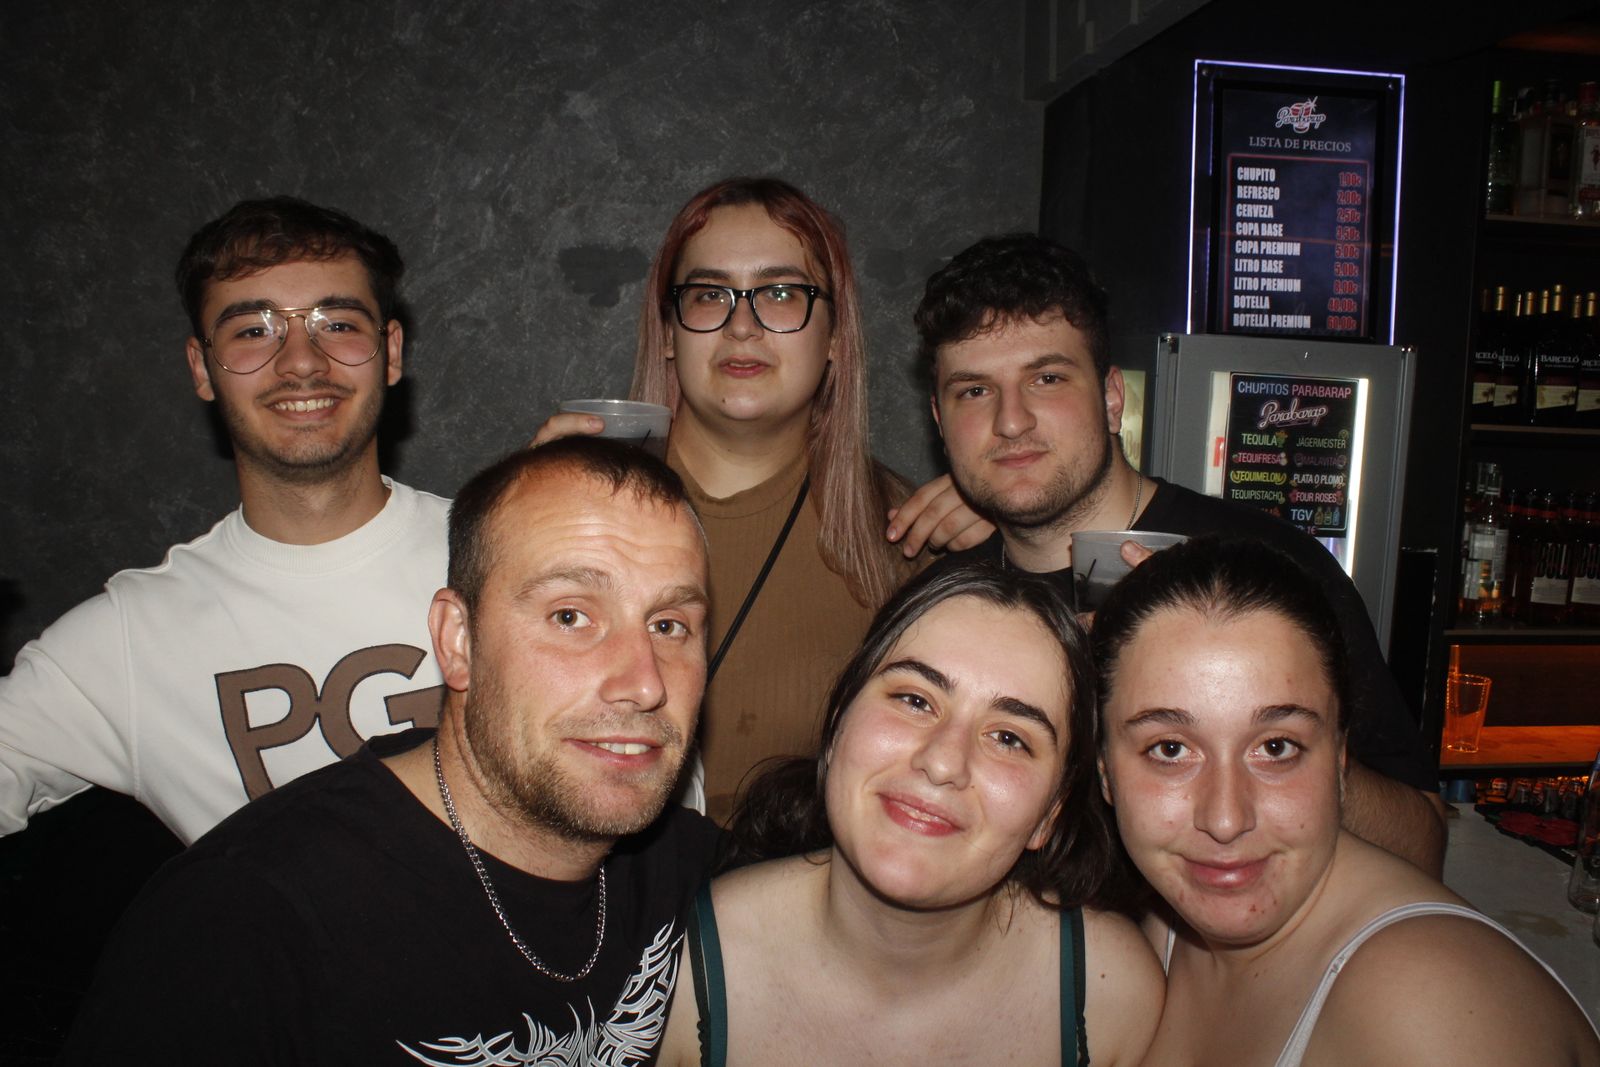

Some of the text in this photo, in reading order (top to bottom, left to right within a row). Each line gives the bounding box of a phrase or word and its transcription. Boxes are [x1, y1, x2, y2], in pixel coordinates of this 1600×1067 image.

[1249, 136, 1352, 152] LISTA DE PRECIOS
[1236, 166, 1276, 182] CHUPITO
[1236, 185, 1280, 200] REFRESCO
[1236, 203, 1274, 219] CERVEZA
[1235, 222, 1259, 237] COPA
[1261, 223, 1284, 238] BASE
[1235, 240, 1259, 255] COPA
[1260, 241, 1301, 256] PREMIUM
[1234, 258, 1259, 273] LITRO
[1261, 259, 1284, 274] BASE
[1234, 277, 1259, 291] LITRO
[1260, 277, 1301, 292] PREMIUM
[1233, 295, 1270, 310] BOTELLA
[1233, 313, 1269, 328] BOTELLA
[1270, 314, 1311, 329] PREMIUM
[1238, 381, 1352, 399] CHUPITOS PARABARAP
[1258, 398, 1328, 429] Parabarap
[1242, 433, 1278, 446] TEQUILA
[1238, 452, 1281, 465] TEQUIFRESA
[1237, 470, 1281, 483] TEQUIMELON
[1293, 473, 1344, 485] PLATA O PLOMO
[1231, 488, 1283, 501] TEQUIPISTACHO
[1296, 491, 1337, 503] FOUR ROSES
[1290, 508, 1313, 521] TGV
